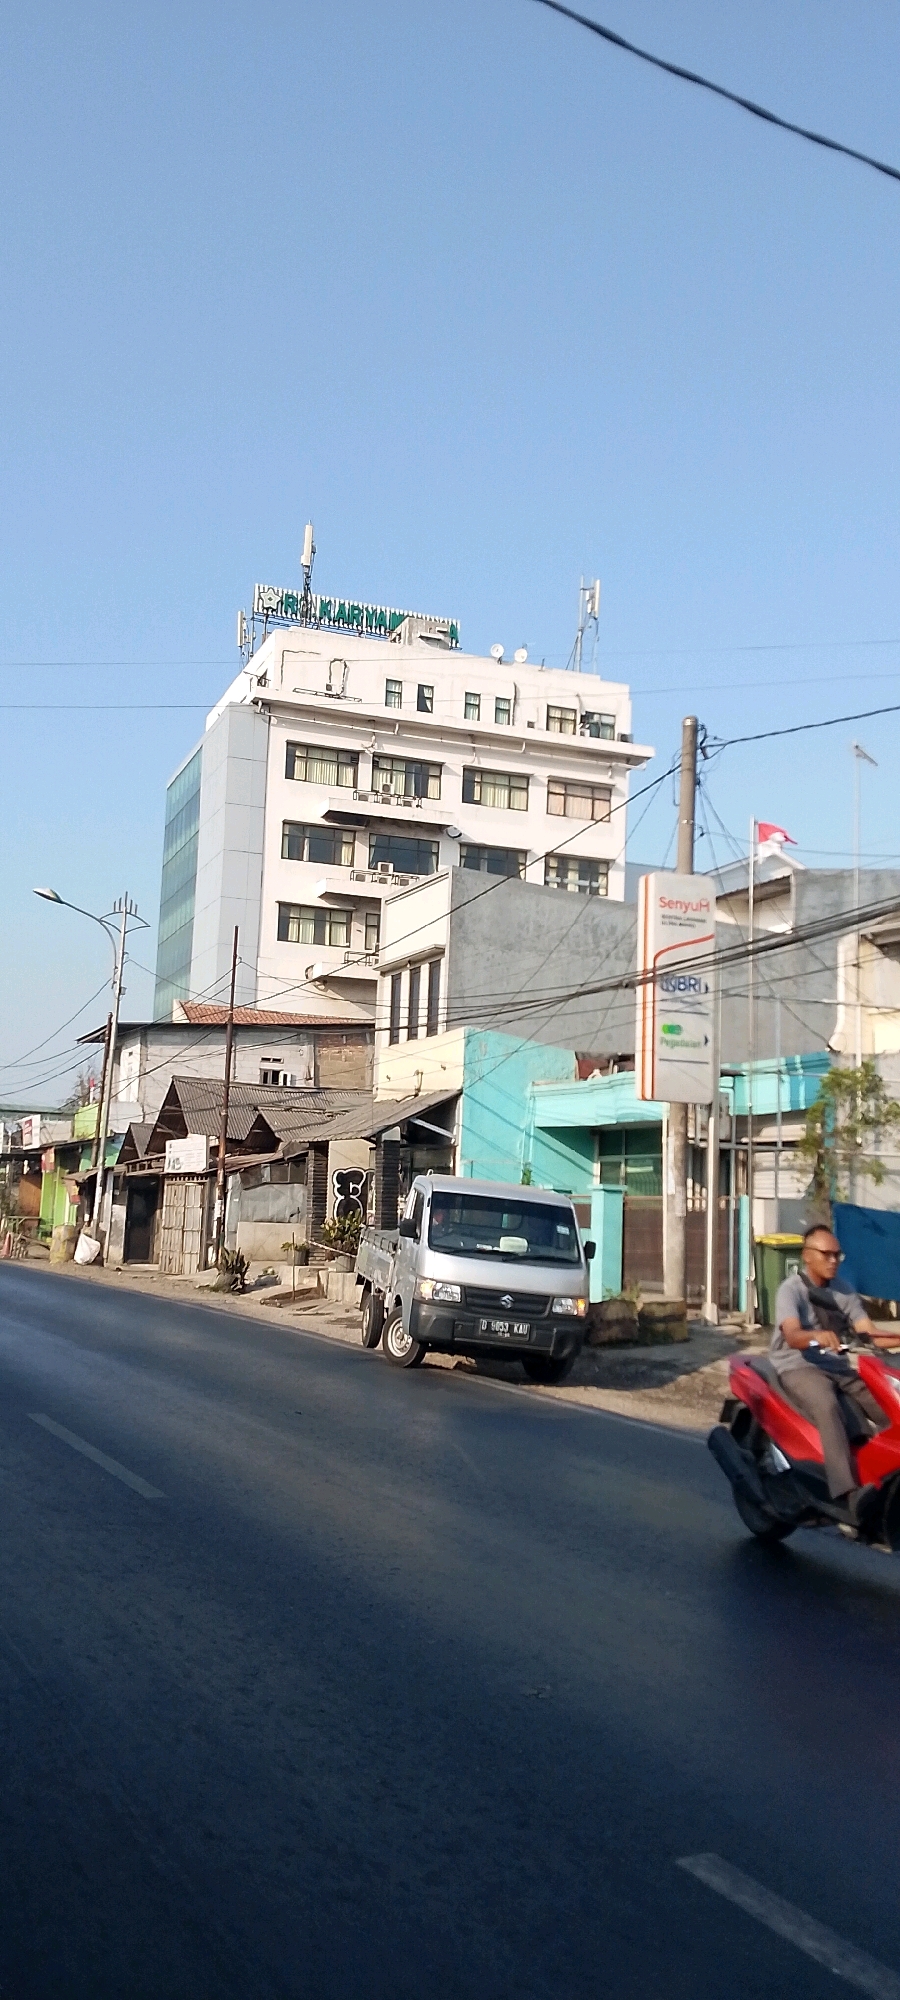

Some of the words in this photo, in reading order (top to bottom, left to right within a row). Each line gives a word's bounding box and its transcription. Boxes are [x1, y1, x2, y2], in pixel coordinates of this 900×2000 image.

[677, 976, 702, 994] BRI
[481, 1320, 488, 1331] D
[513, 1323, 528, 1335] KAU
